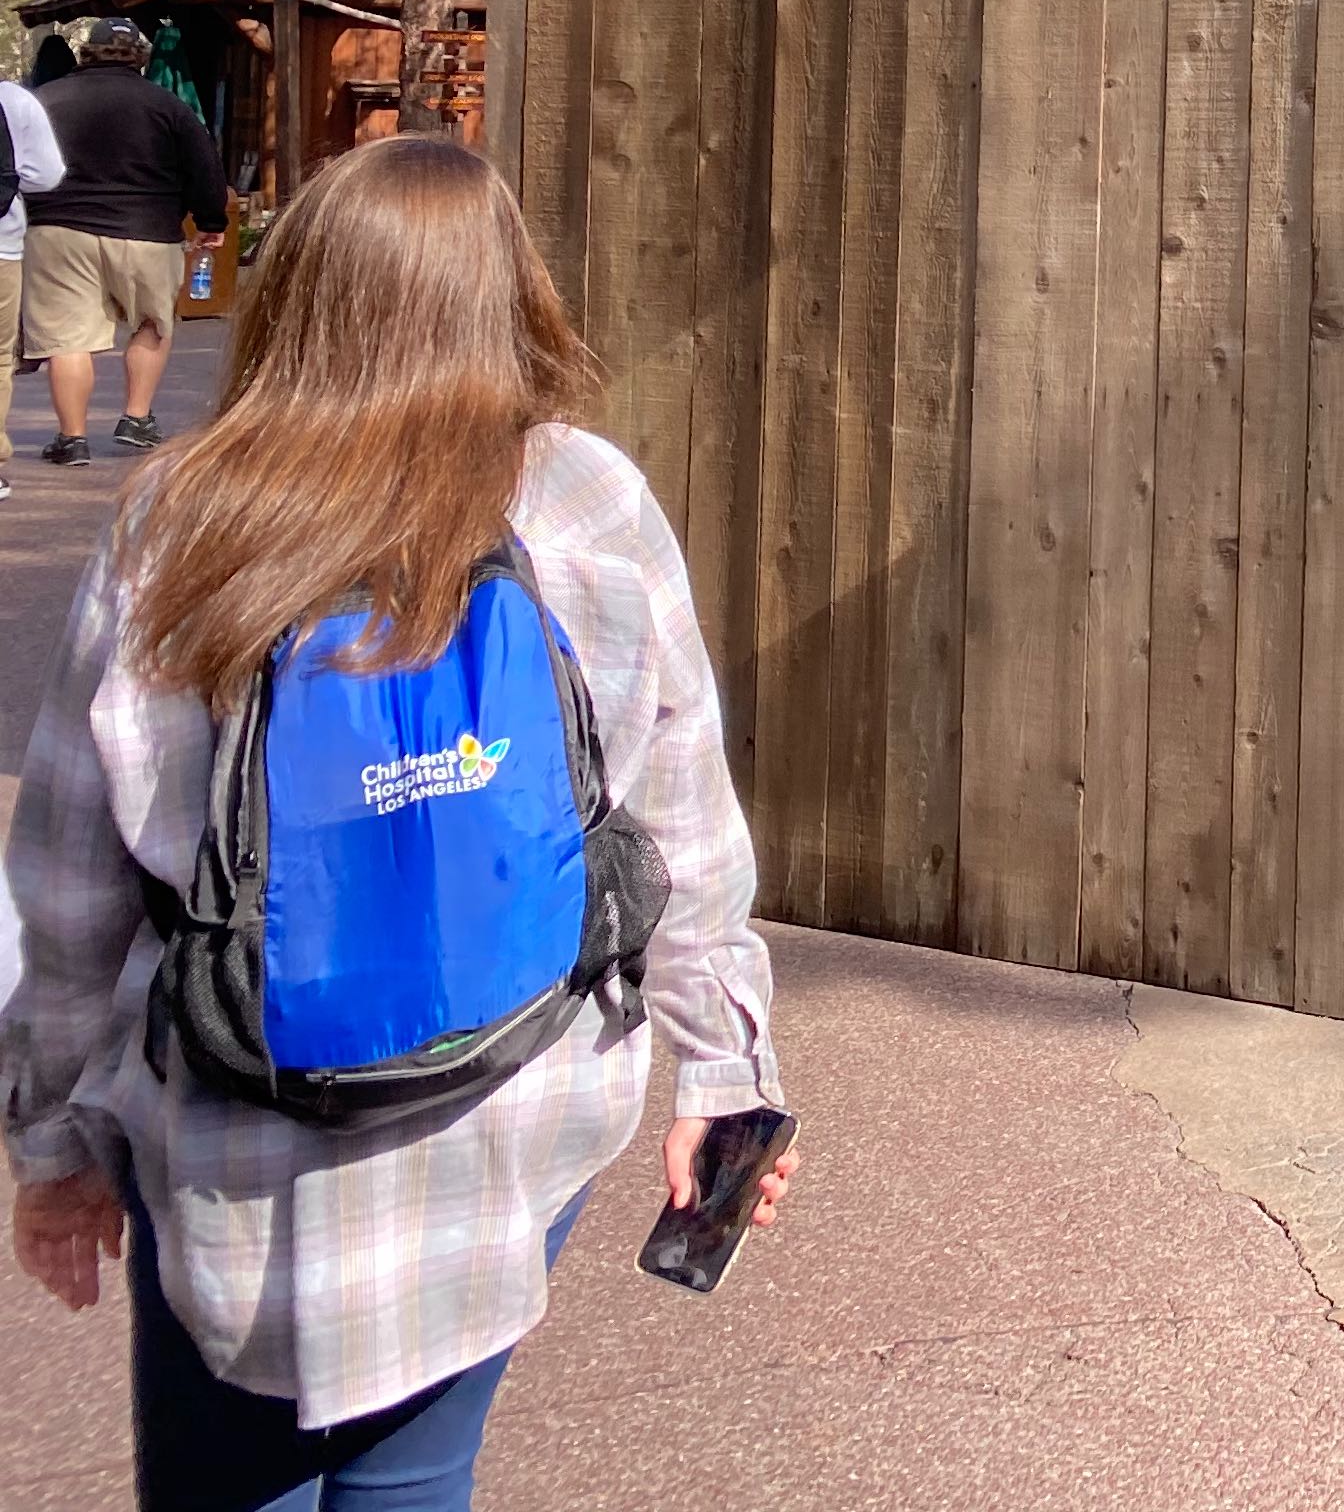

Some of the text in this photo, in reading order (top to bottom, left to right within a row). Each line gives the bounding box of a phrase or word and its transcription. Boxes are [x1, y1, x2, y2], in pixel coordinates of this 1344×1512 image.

[361, 748, 458, 786] Children's
[364, 762, 456, 805] Hospital
[376, 795, 405, 815] LOS
